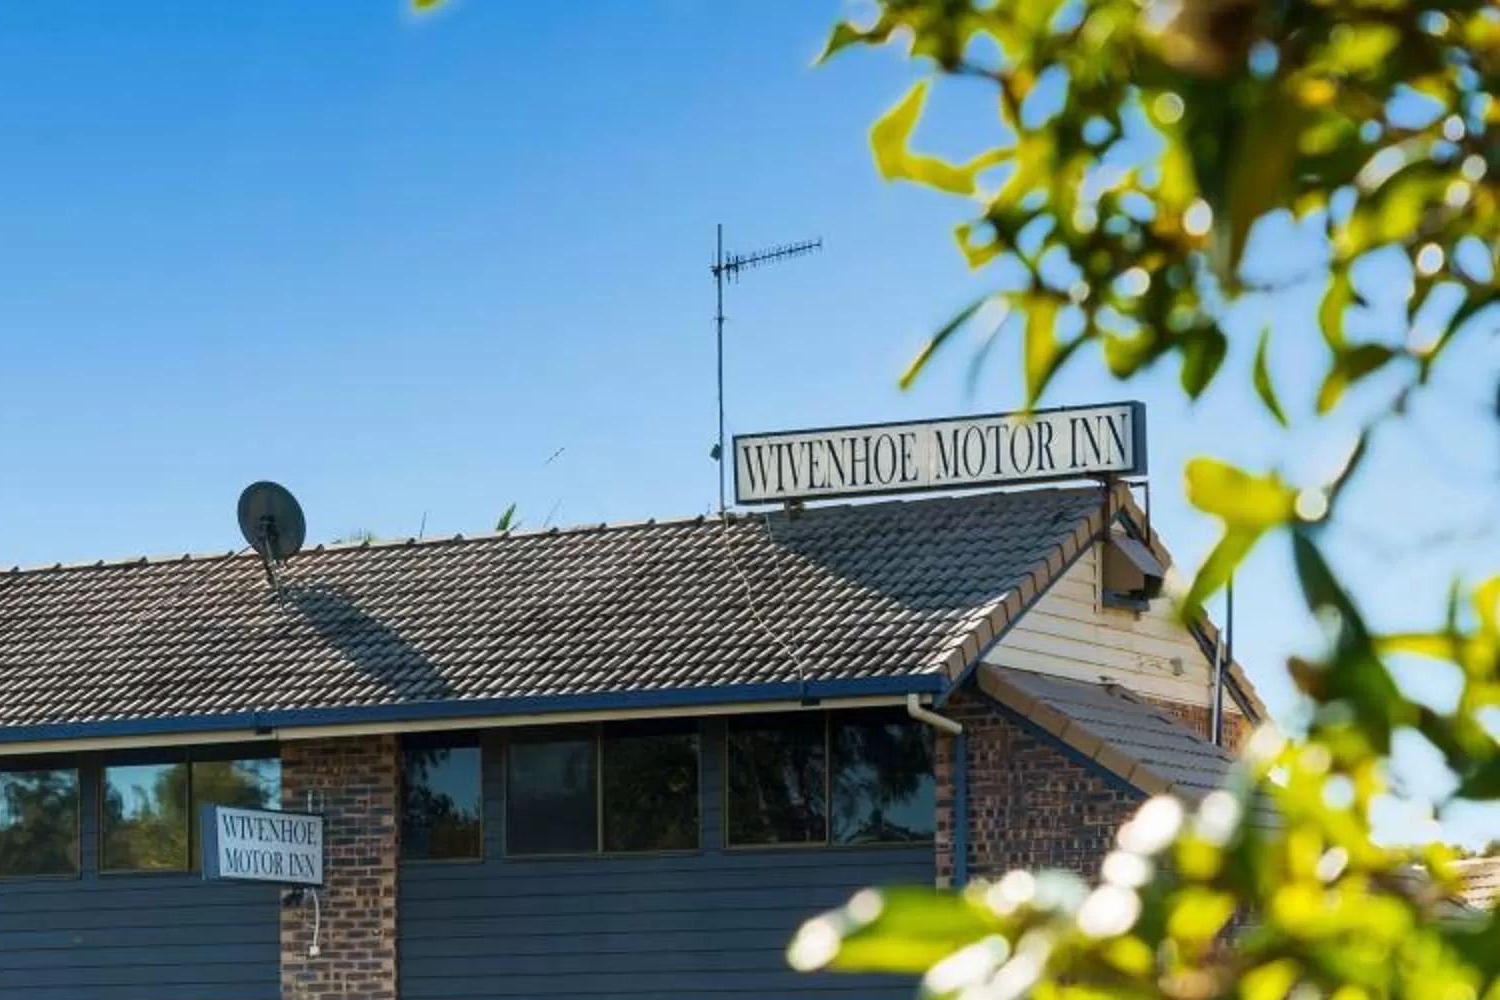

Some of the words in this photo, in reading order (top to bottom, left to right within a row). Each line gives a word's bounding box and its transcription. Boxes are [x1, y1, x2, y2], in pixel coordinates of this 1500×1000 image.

[742, 433, 918, 493] WIVENHOE
[935, 420, 1056, 479] MOTOR
[1069, 413, 1128, 467] INN
[222, 814, 317, 845] WIVENHOE
[225, 847, 283, 875] MOTOR
[289, 852, 316, 878] INN
